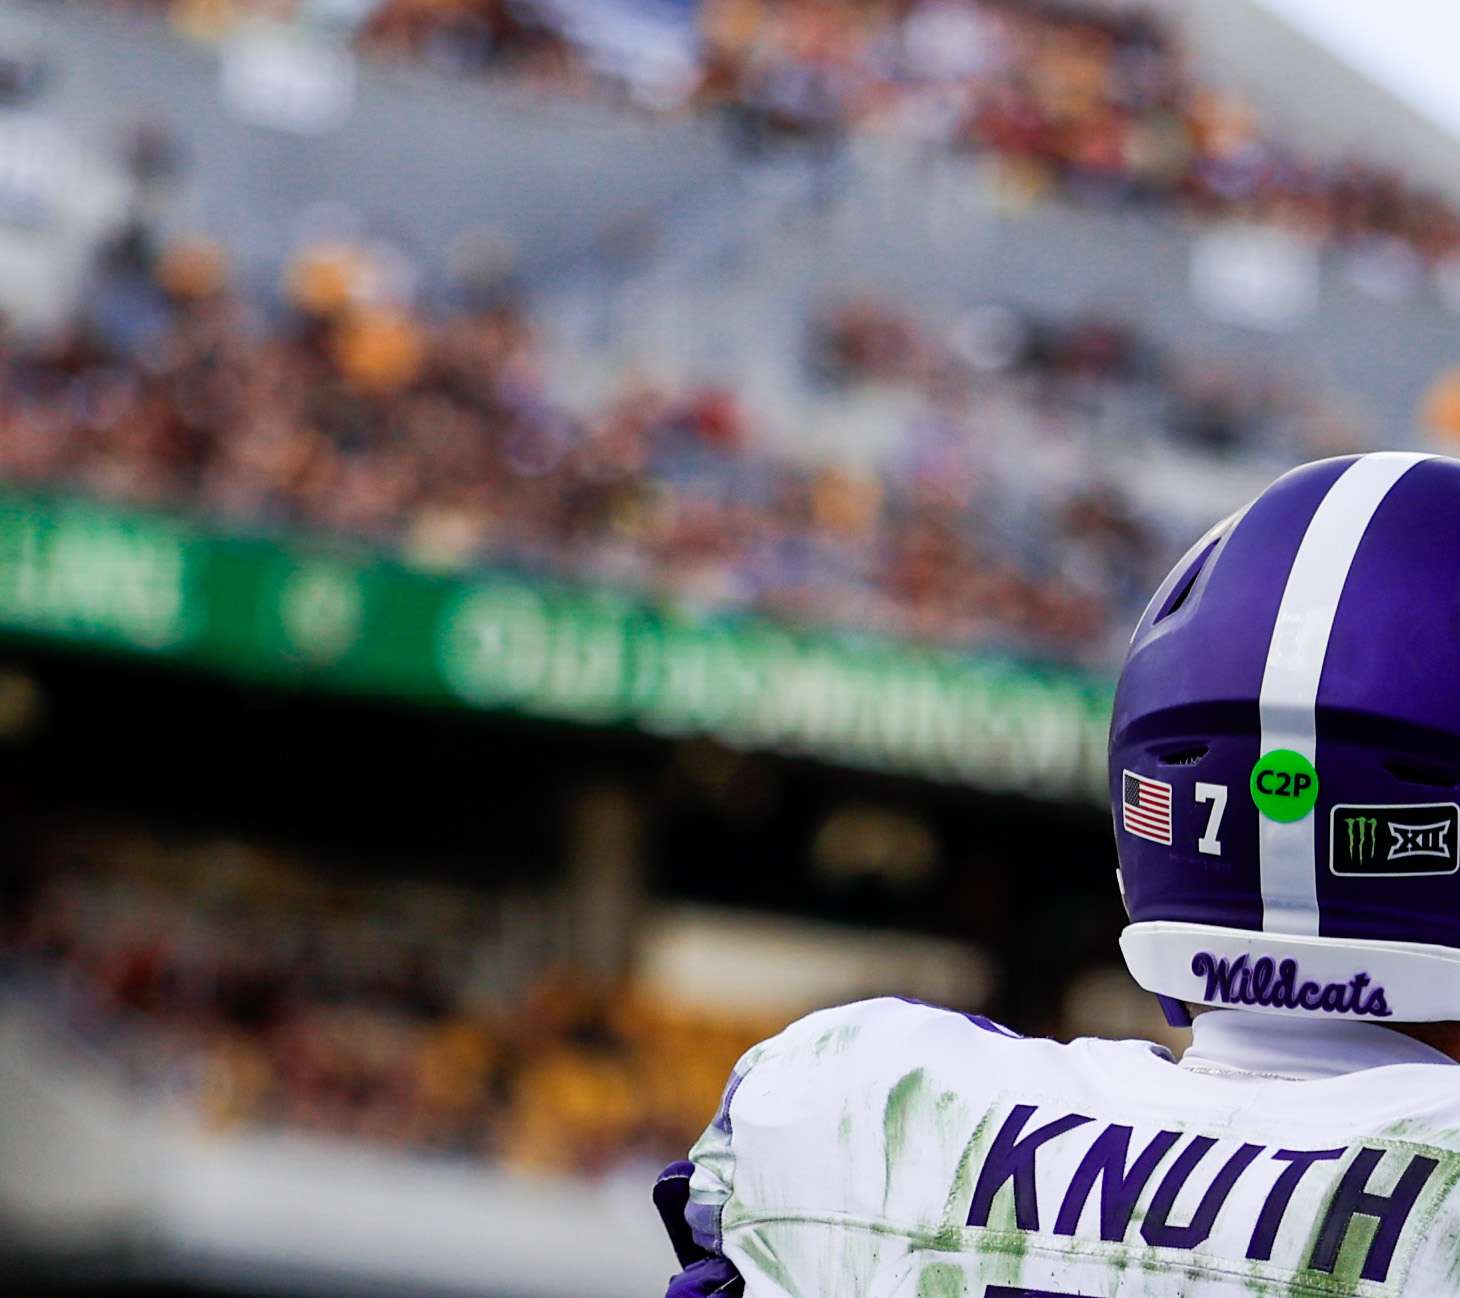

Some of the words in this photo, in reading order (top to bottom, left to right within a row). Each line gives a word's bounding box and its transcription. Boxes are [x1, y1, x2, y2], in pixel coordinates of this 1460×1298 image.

[1256, 769, 1311, 797] C2P
[1195, 781, 1228, 856] 7
[1191, 952, 1393, 1017] Wildcats
[966, 1104, 1440, 1283] KNUTH
